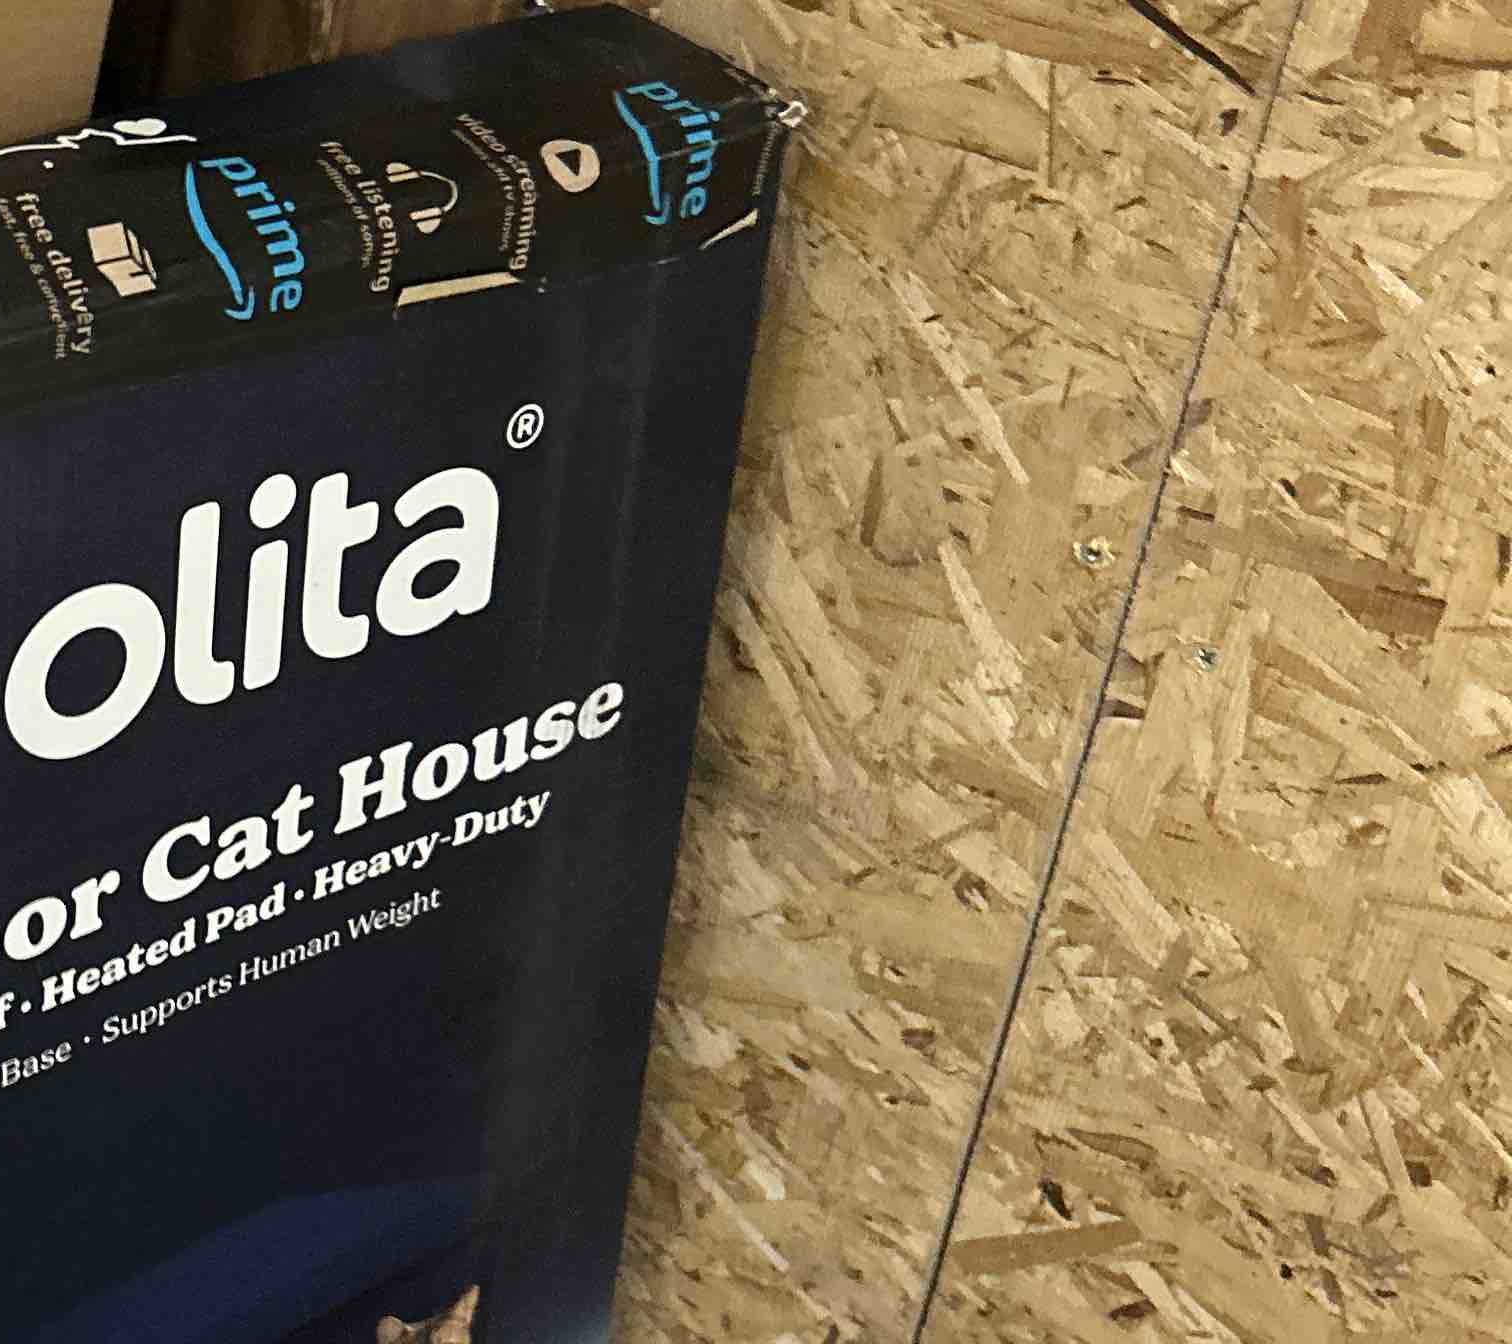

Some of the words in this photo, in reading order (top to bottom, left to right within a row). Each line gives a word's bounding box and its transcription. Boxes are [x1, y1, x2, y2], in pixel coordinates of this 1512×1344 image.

[626, 81, 721, 220] prime
[15, 193, 54, 244] free
[46, 249, 95, 355] delivery
[197, 156, 305, 313] prime
[357, 179, 401, 293] listening
[142, 783, 315, 903] Cat
[333, 682, 624, 835] House
[41, 916, 197, 1012] Heated
[204, 881, 286, 944] Pad
[312, 791, 551, 901] Heavy-Duty
[0, 1041, 72, 1088] Base
[102, 974, 233, 1044] Supports
[239, 930, 341, 986] Human
[347, 887, 441, 940] Weight
